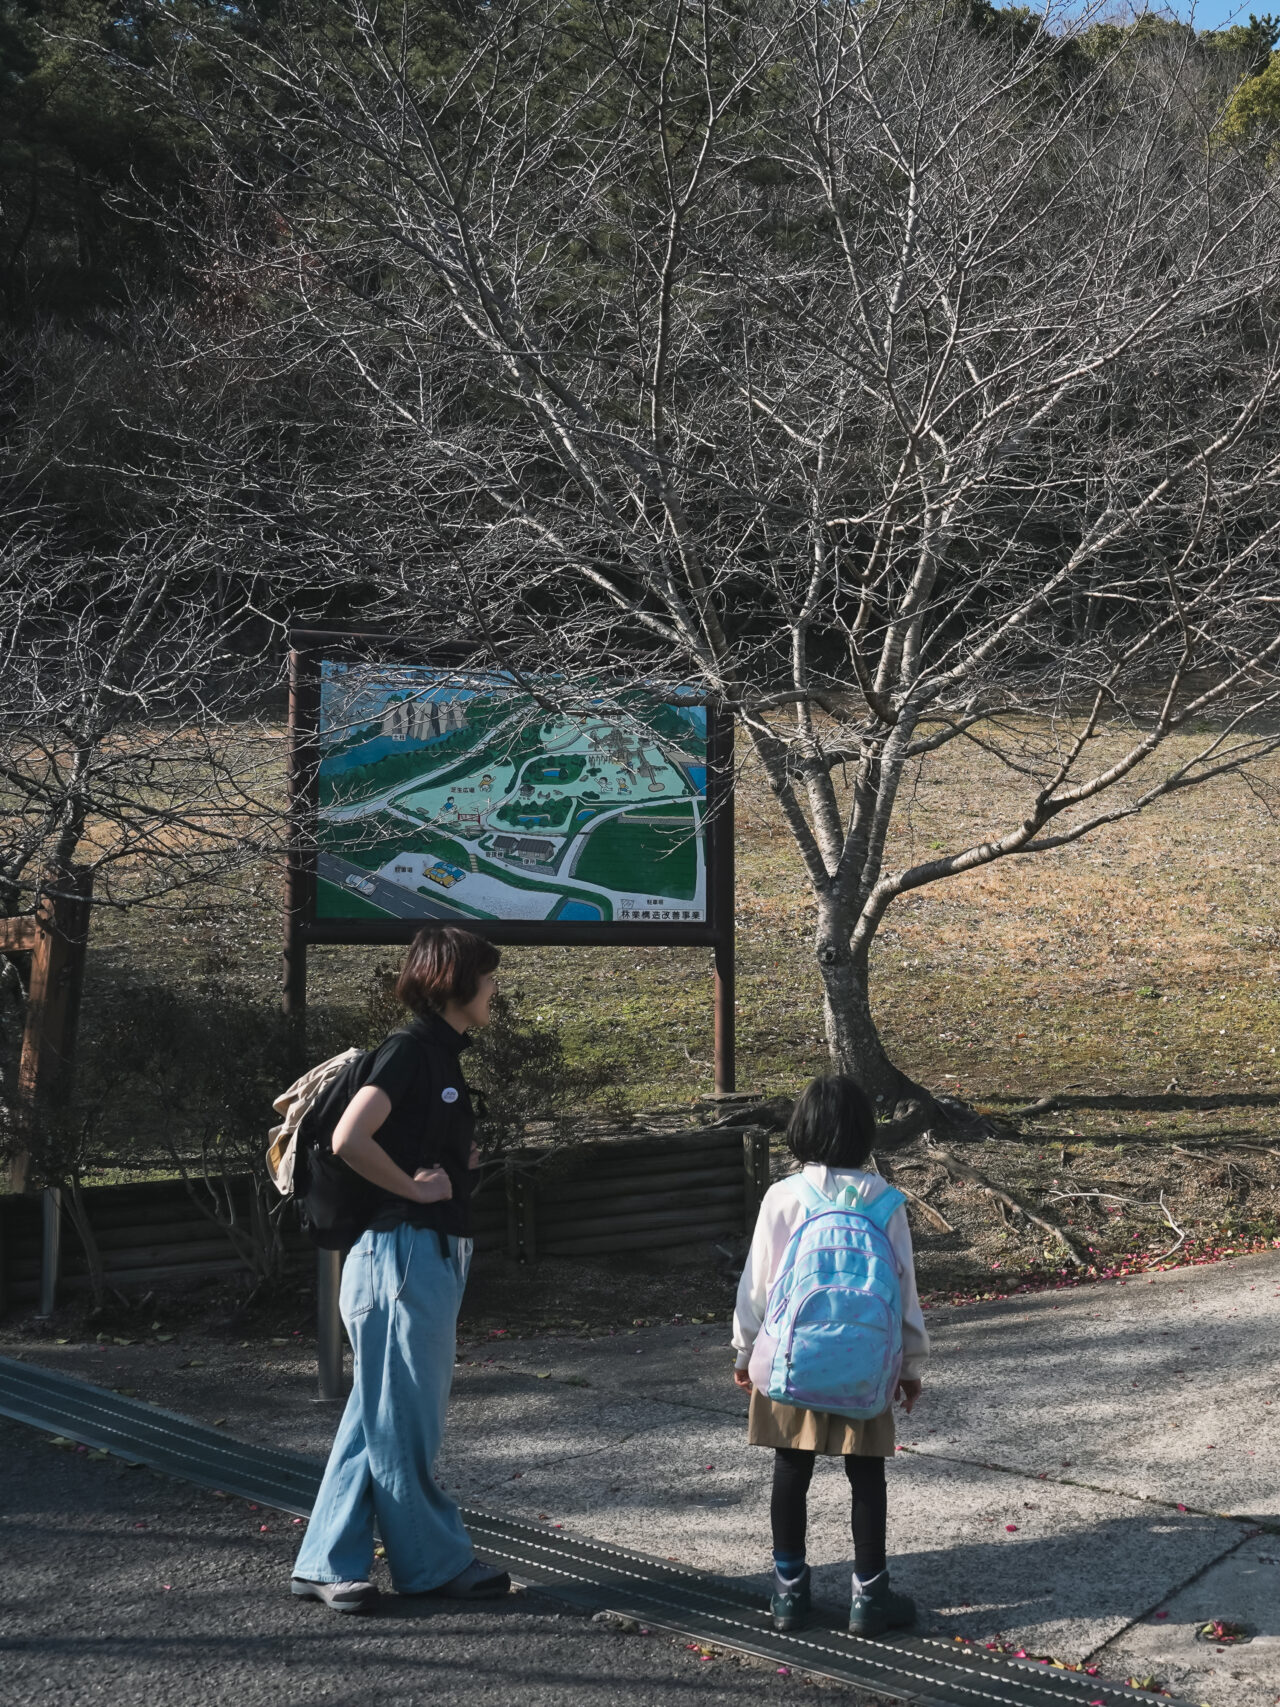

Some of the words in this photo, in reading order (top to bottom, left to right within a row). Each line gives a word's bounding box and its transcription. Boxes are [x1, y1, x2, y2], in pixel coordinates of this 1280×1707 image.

[621, 910, 701, 920] 林業構造改善事業
